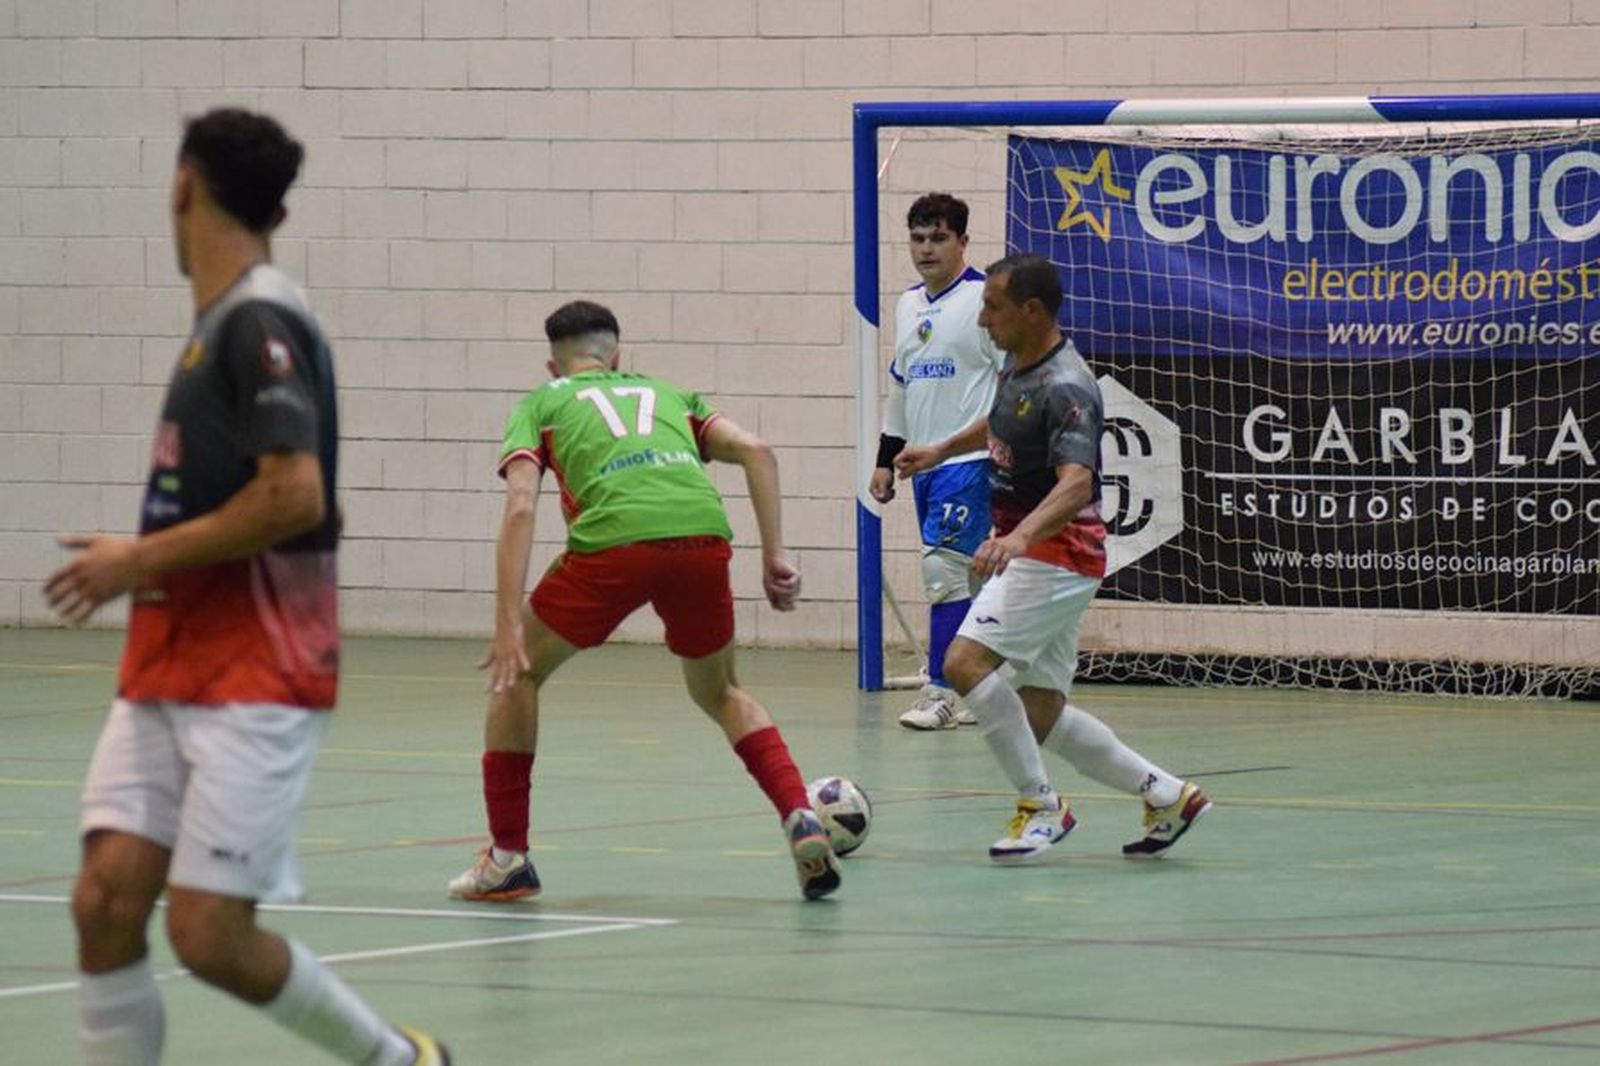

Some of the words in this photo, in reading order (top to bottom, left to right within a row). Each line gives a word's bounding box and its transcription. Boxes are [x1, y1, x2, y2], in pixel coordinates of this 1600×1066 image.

[1283, 258, 1600, 301] electrodomést
[575, 387, 656, 438] 17
[1241, 403, 1598, 466] GARBLA
[1220, 493, 1414, 522] ESTUDIOS
[1443, 497, 1487, 522] DE
